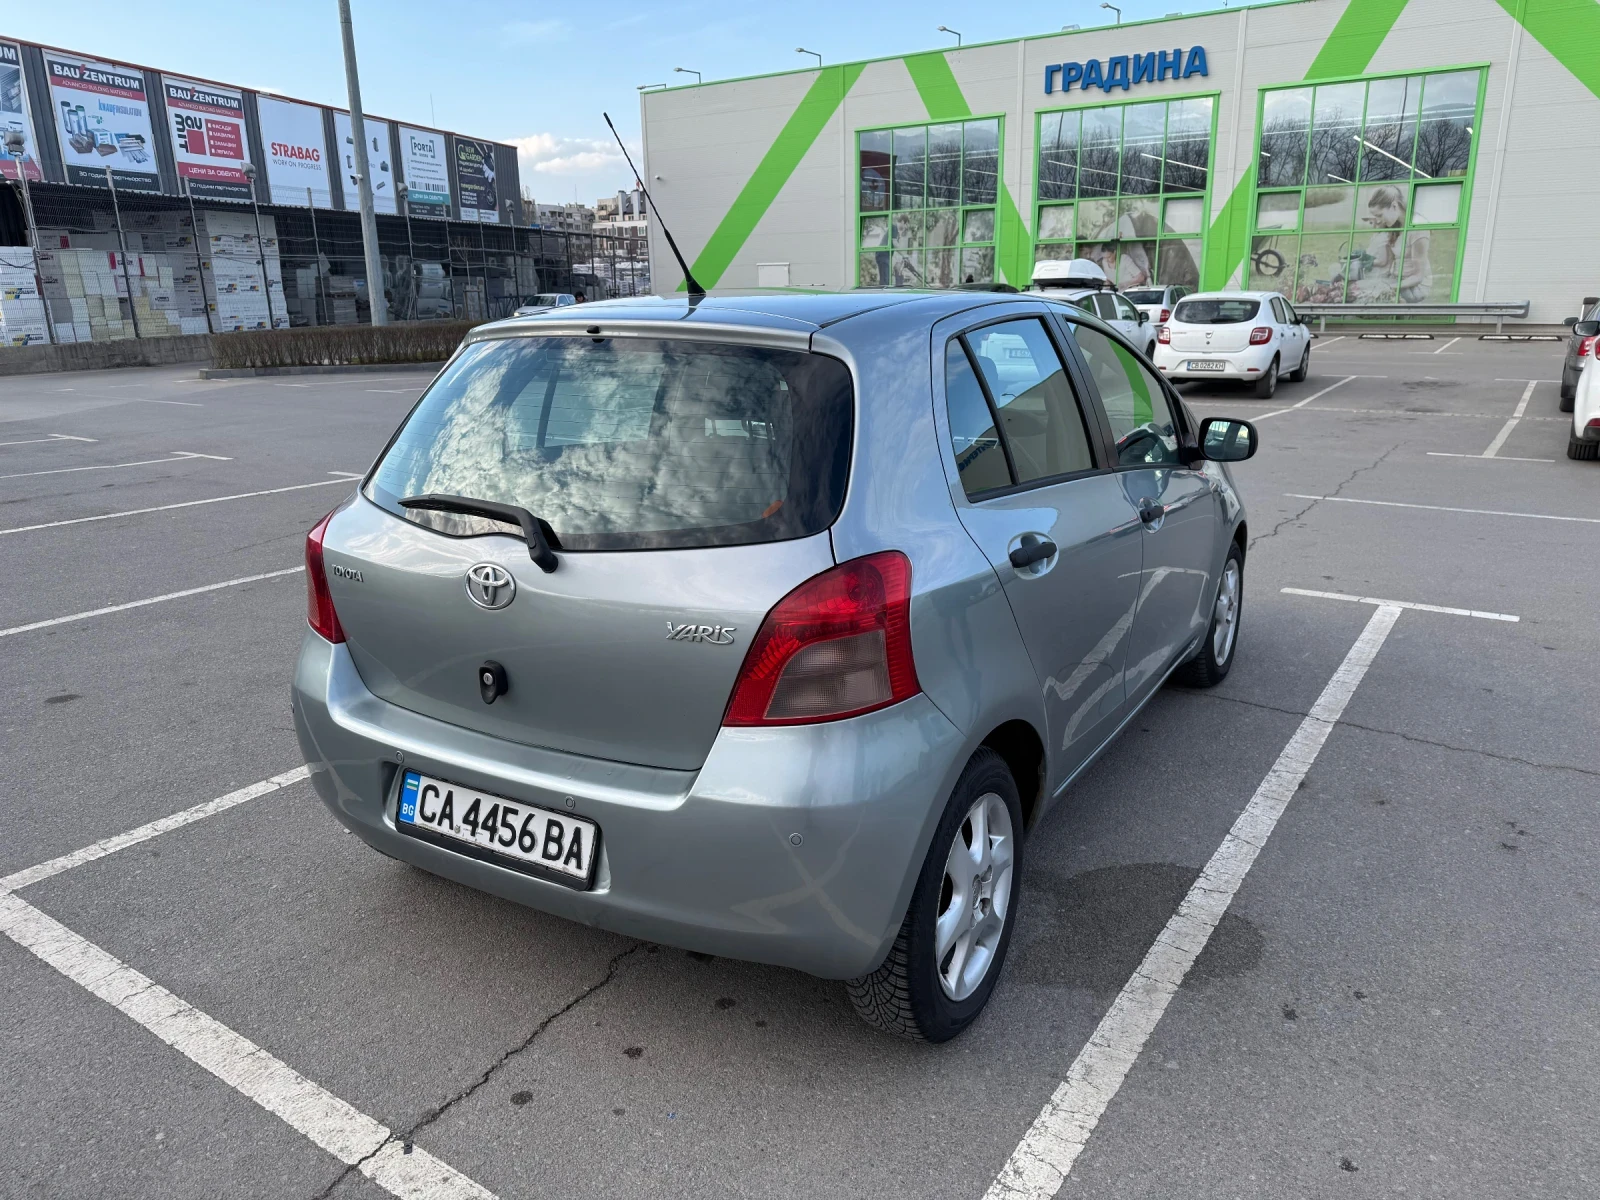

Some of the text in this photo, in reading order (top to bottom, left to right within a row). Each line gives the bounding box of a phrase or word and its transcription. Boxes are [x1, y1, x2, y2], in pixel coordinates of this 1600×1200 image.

[53, 64, 140, 90] BAU ZENTRUM
[1044, 45, 1208, 94] ГРАДИНА
[62, 80, 133, 98] ADVANCED BUILDING MATERIALS
[169, 87, 239, 109] BAU ZENTRUM
[271, 142, 320, 162] STRABAG
[413, 142, 433, 153] PORTA
[188, 166, 207, 174] ЦЕНИ
[297, 162, 322, 171] PROGRESS
[331, 564, 364, 583] TOYOTA
[402, 803, 415, 816] BG
[419, 783, 583, 870] CA 4456 BA
